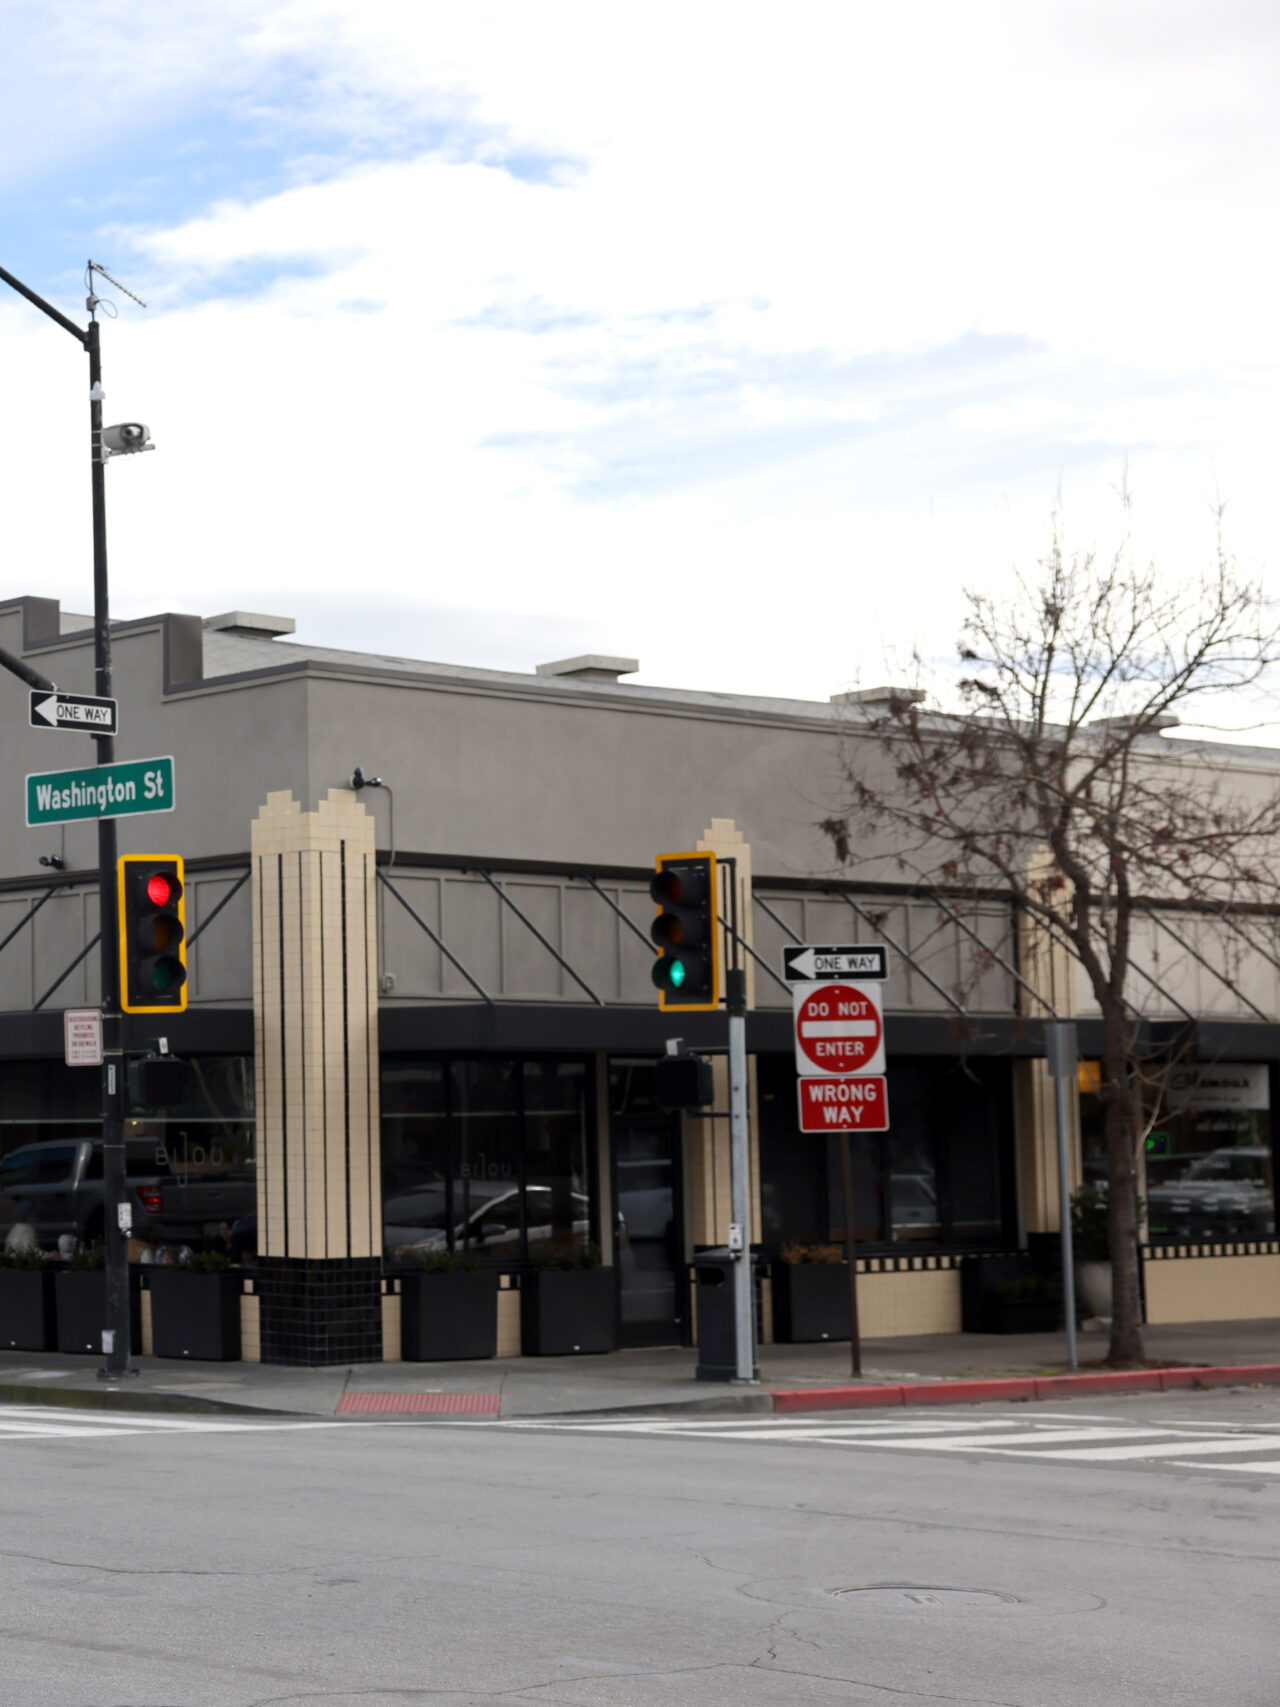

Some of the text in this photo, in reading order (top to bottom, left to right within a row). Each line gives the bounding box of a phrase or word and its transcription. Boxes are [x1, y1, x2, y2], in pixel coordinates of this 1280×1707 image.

[57, 705, 108, 722] ONE WAY
[36, 770, 165, 812] Washington St
[814, 956, 876, 970] ONE WAY
[807, 1001, 868, 1017] DO NOT
[815, 1041, 865, 1056] ENTER
[809, 1084, 877, 1103] WRONG
[822, 1106, 864, 1124] WAY
